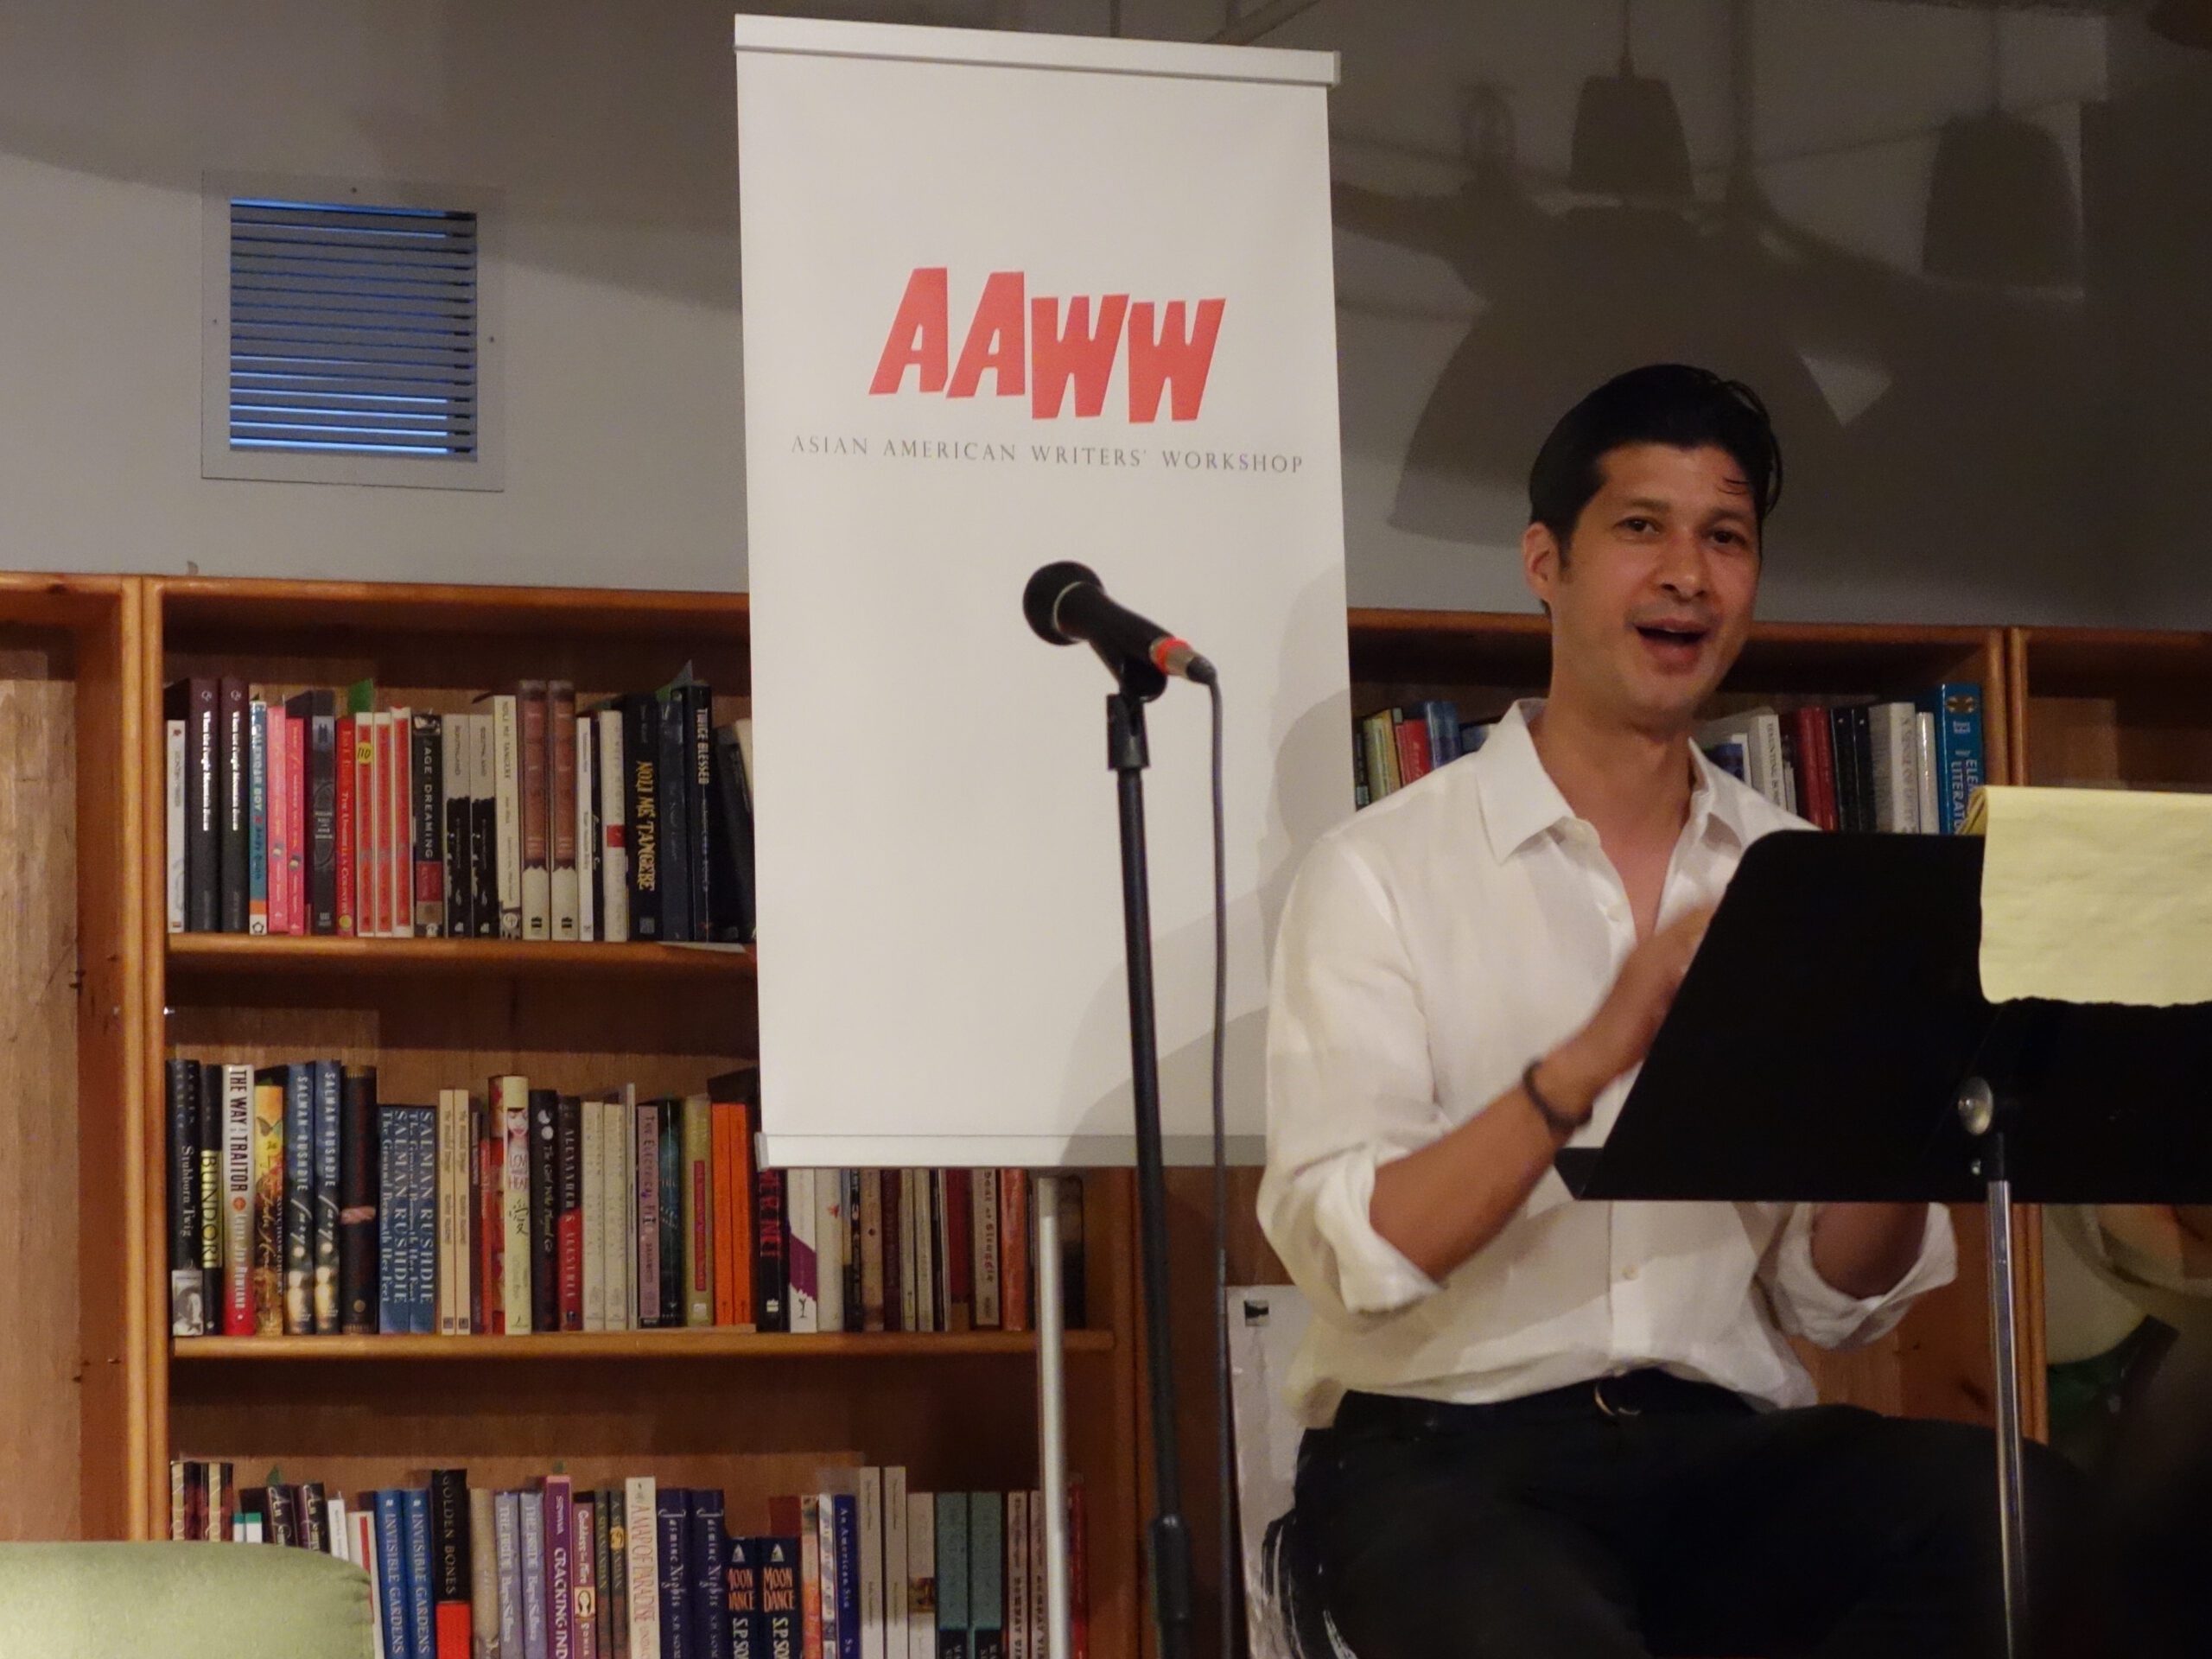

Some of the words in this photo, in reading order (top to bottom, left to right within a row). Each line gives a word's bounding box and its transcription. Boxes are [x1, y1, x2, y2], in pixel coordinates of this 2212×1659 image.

[868, 267, 1227, 424] AAWW
[791, 434, 868, 455] ASIAN
[882, 440, 1016, 462] AMERICAN
[1162, 449, 1303, 474] WORKSHOP
[202, 711, 211, 732] When
[202, 734, 211, 745] the
[232, 711, 240, 732] When
[232, 734, 240, 745] the
[696, 709, 709, 741] TWICE
[423, 747, 432, 774] AGE
[636, 760, 654, 792] NOLI
[697, 742, 709, 785] BLESSED
[202, 772, 211, 808] Mountain
[232, 772, 240, 808] Mountain
[255, 788, 264, 811] BOY
[637, 796, 656, 817] ME
[423, 785, 434, 858] DREAMING
[230, 1070, 248, 1092] THE
[296, 1076, 308, 1127] SALMAN
[324, 1072, 336, 1122] SALMAN
[230, 1097, 248, 1125] WAY
[382, 1111, 392, 1135] The
[181, 1145, 194, 1204] Stubborn
[230, 1135, 249, 1192] TRAITOR
[296, 1134, 308, 1192] RUSHDIE
[324, 1130, 336, 1187] RUSHDIE
[382, 1139, 392, 1187] Ground
[394, 1110, 407, 1198] SALMAN
[420, 1111, 433, 1198] SALMAN
[181, 1206, 196, 1237] Twig
[200, 1157, 219, 1267] BUNDORI
[382, 1191, 392, 1243] Beneath
[382, 1247, 392, 1272] Her
[394, 1207, 407, 1303] RUSHDIE
[420, 1208, 434, 1304] RUSHDIE
[382, 1274, 392, 1302] Feet
[442, 1476, 454, 1539] GOLDEN
[632, 1505, 651, 1514] A
[385, 1513, 400, 1583] INVISIBLE
[411, 1513, 427, 1583] INVISIBLE
[632, 1516, 652, 1545] MAP
[658, 1507, 687, 1561] Jasmine
[696, 1507, 724, 1561] Jasmine
[444, 1545, 456, 1595] BONES
[632, 1546, 653, 1562] OF
[841, 1528, 850, 1586] American
[554, 1547, 568, 1628] CRACKING
[633, 1567, 656, 1623] PARADISE
[660, 1564, 687, 1607] Nights
[698, 1565, 723, 1607] Nights
[763, 1566, 793, 1591] MOON
[388, 1586, 404, 1655] GARDENS
[415, 1587, 430, 1654] GARDENS
[763, 1590, 795, 1613] DANCE
